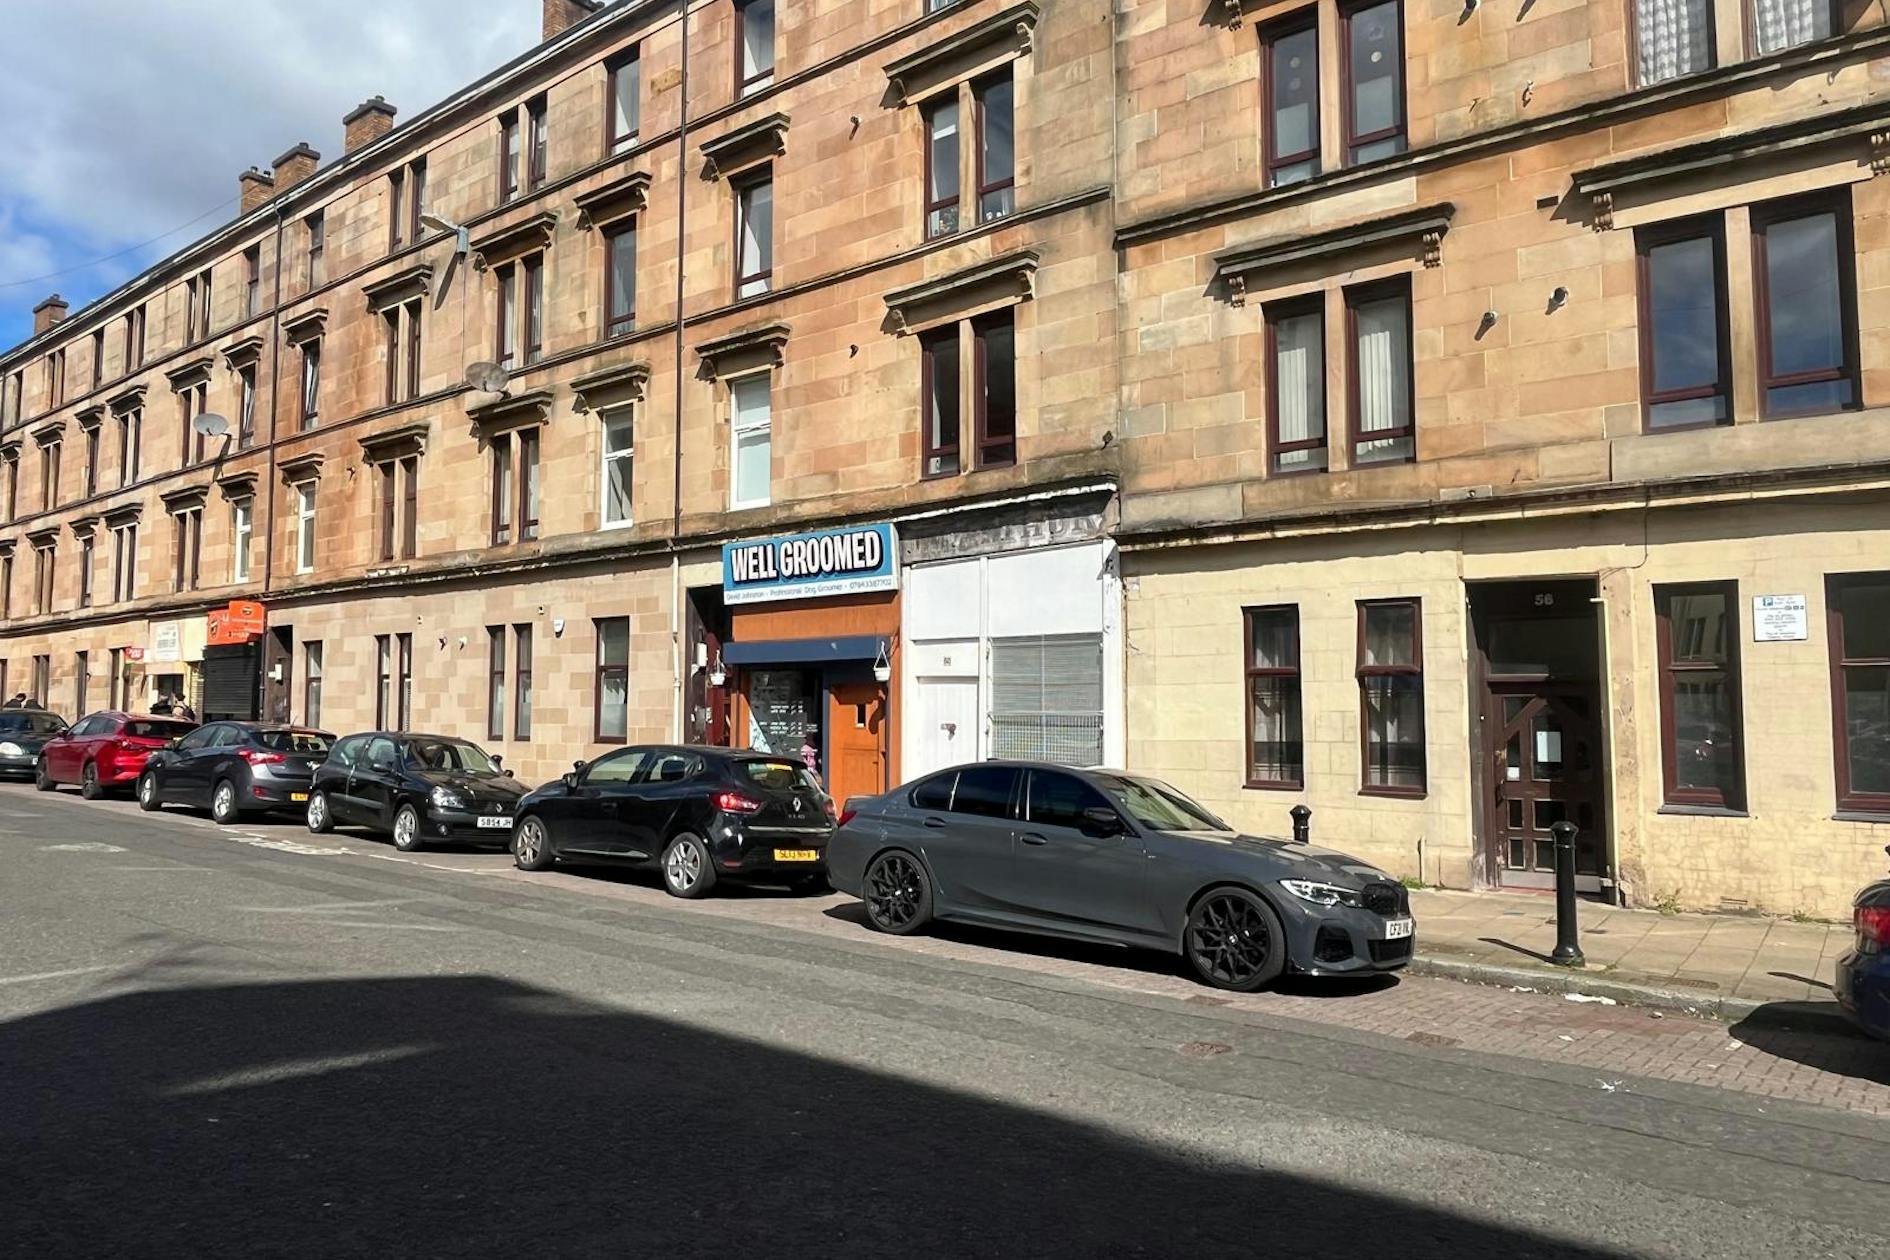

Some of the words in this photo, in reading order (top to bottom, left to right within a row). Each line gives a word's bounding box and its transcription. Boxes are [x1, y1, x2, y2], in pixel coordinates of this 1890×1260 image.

[731, 544, 777, 581] WELL
[779, 531, 880, 576] GROOMED
[804, 586, 816, 595] Dog
[817, 583, 843, 592] Groomer
